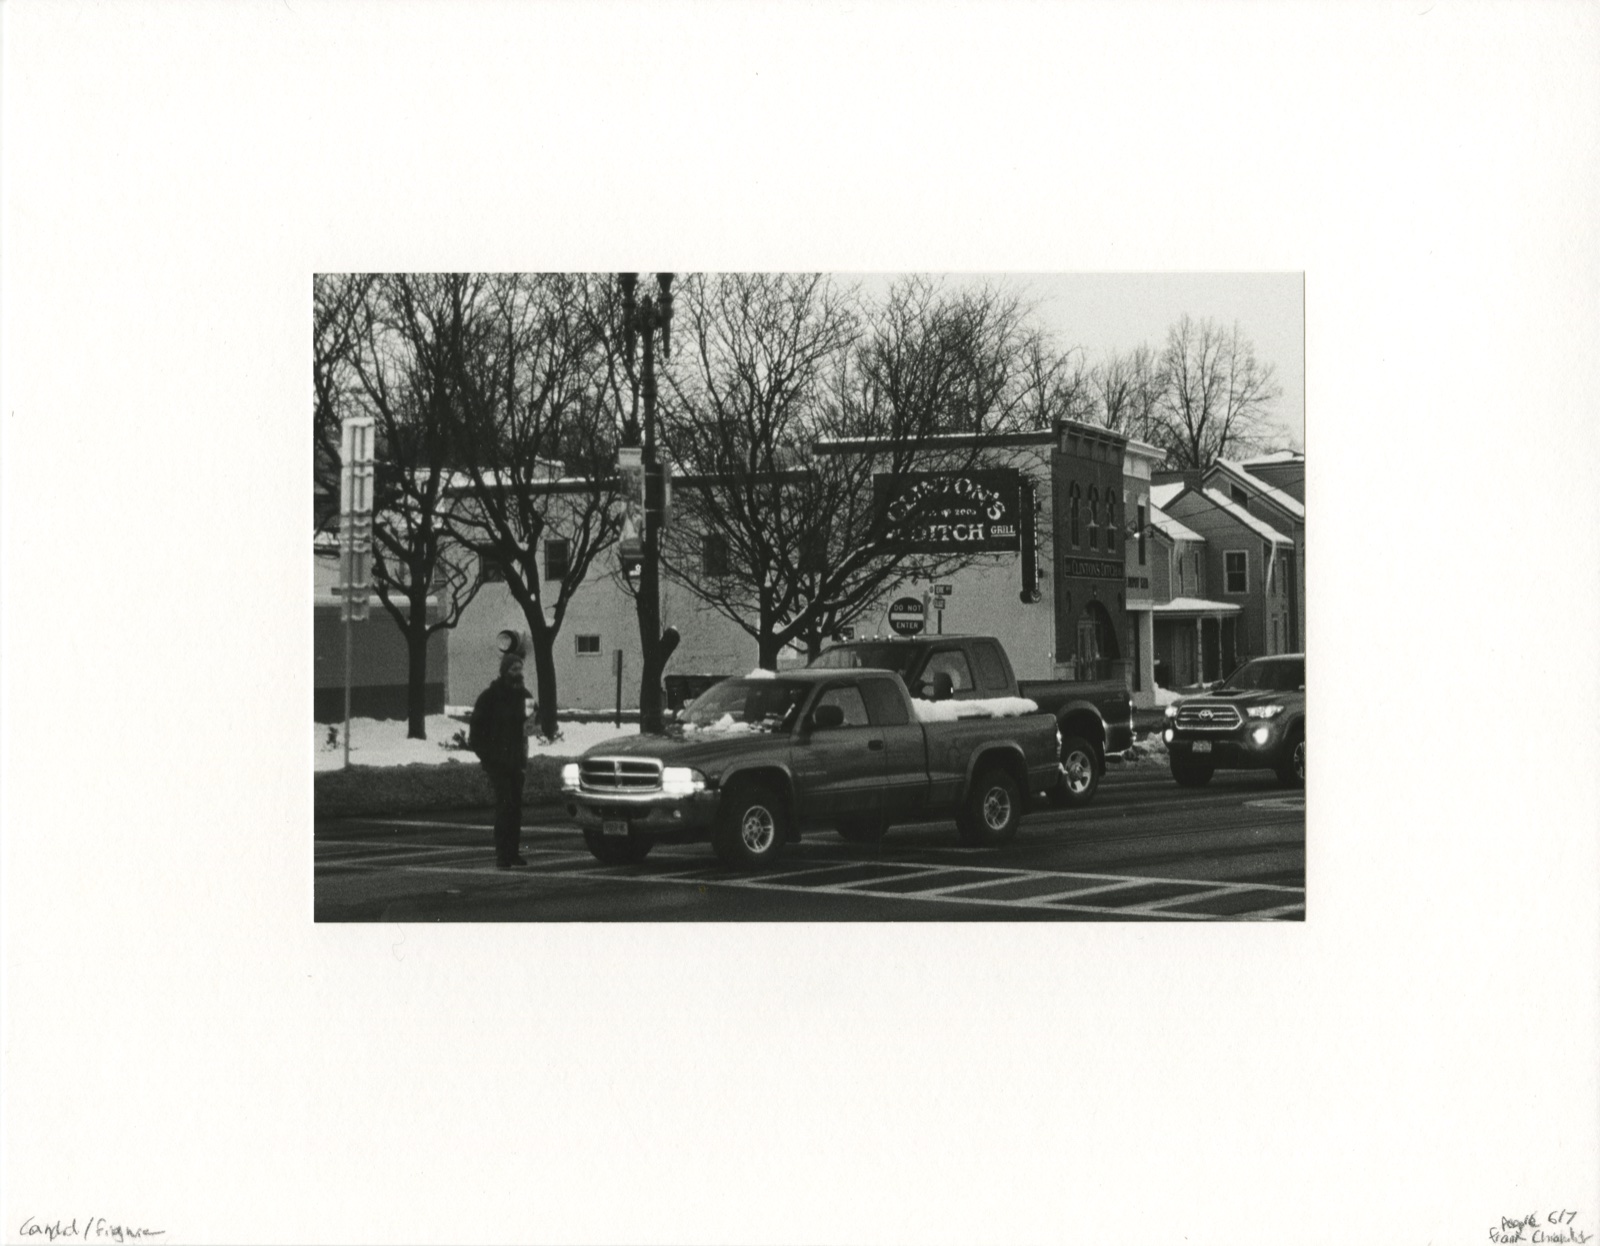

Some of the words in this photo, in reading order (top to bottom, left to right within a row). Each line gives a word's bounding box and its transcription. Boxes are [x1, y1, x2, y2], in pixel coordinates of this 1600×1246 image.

[990, 524, 1016, 535] GRILL
[893, 604, 904, 612] DO
[907, 604, 922, 612] NOT
[896, 621, 919, 629] ENTER
